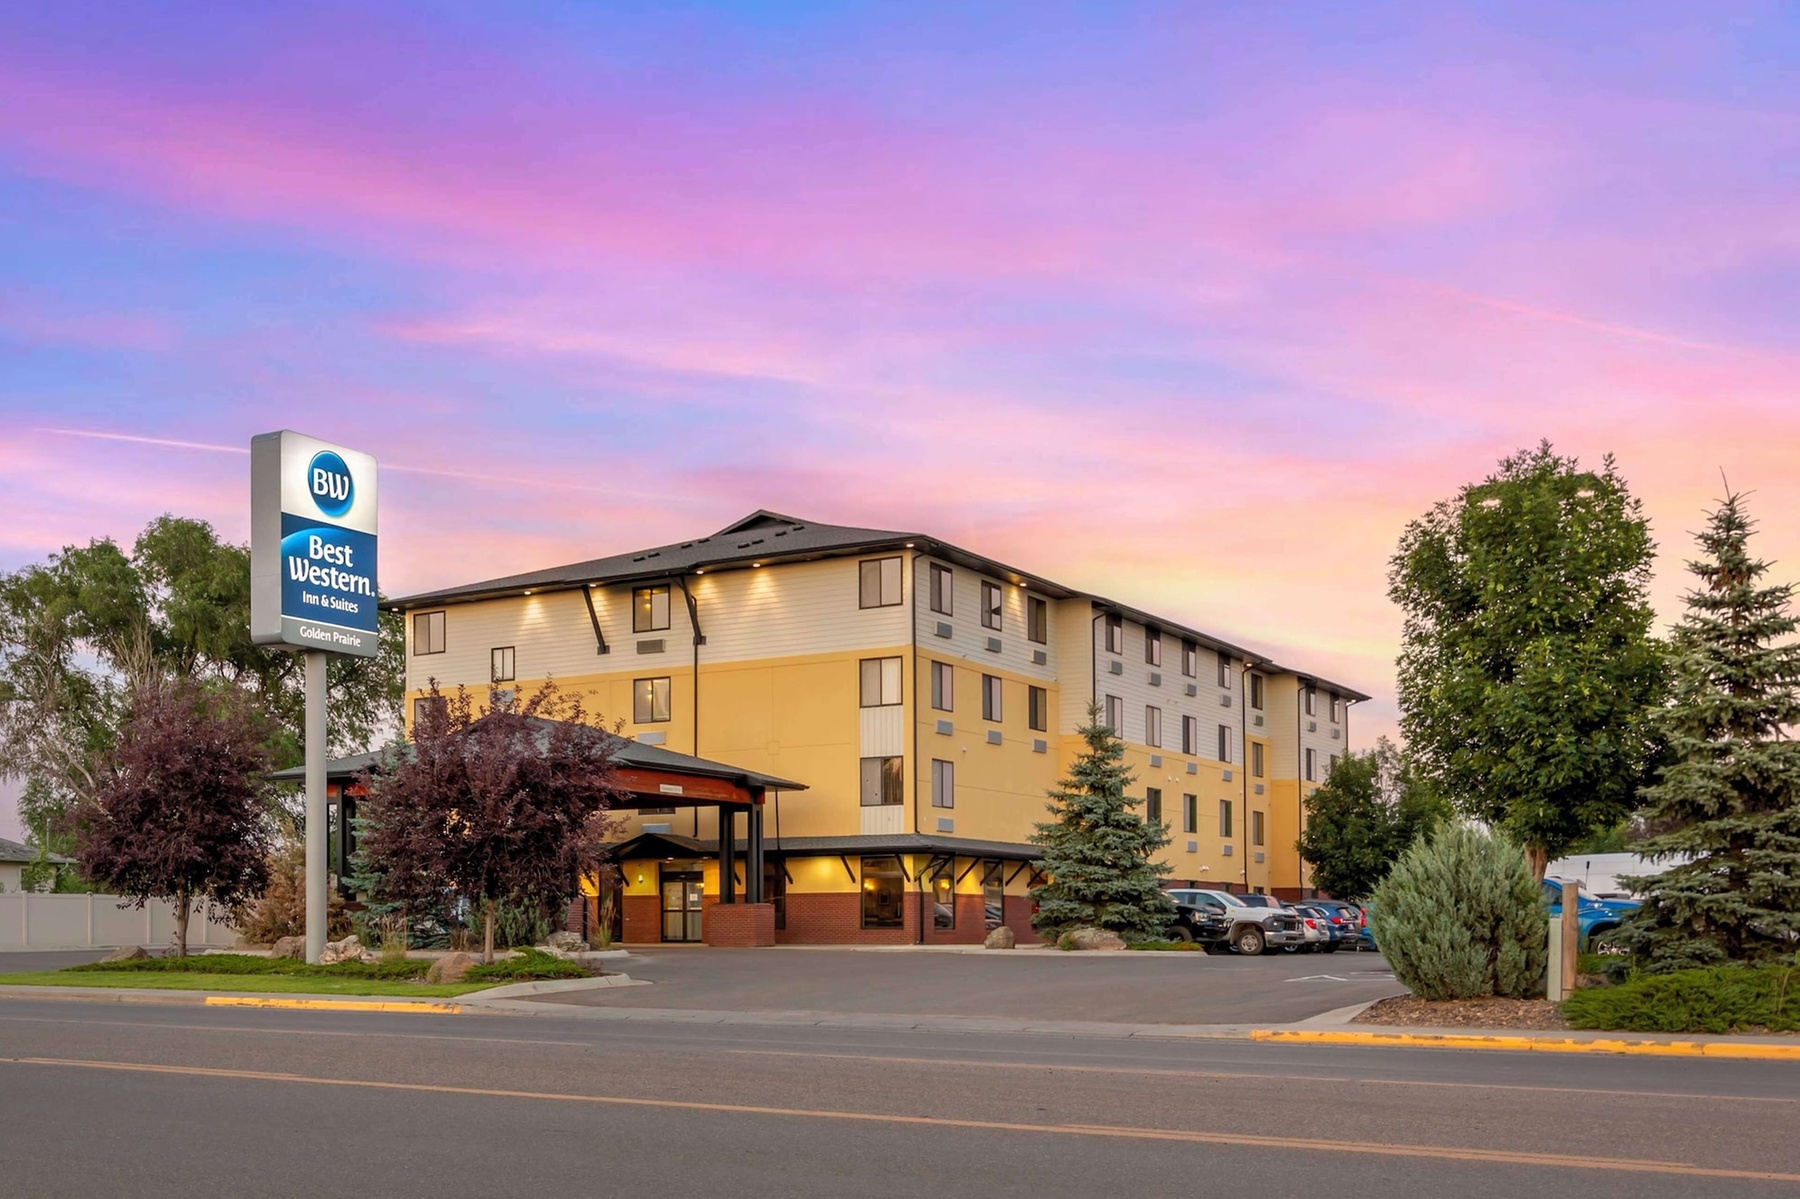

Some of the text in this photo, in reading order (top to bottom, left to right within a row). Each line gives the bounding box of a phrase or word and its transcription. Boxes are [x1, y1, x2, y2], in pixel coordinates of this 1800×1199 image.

[313, 468, 349, 501] BW
[309, 535, 354, 568] Best
[302, 590, 359, 614] Inn & Suites
[299, 625, 361, 647] Golden Prairie
